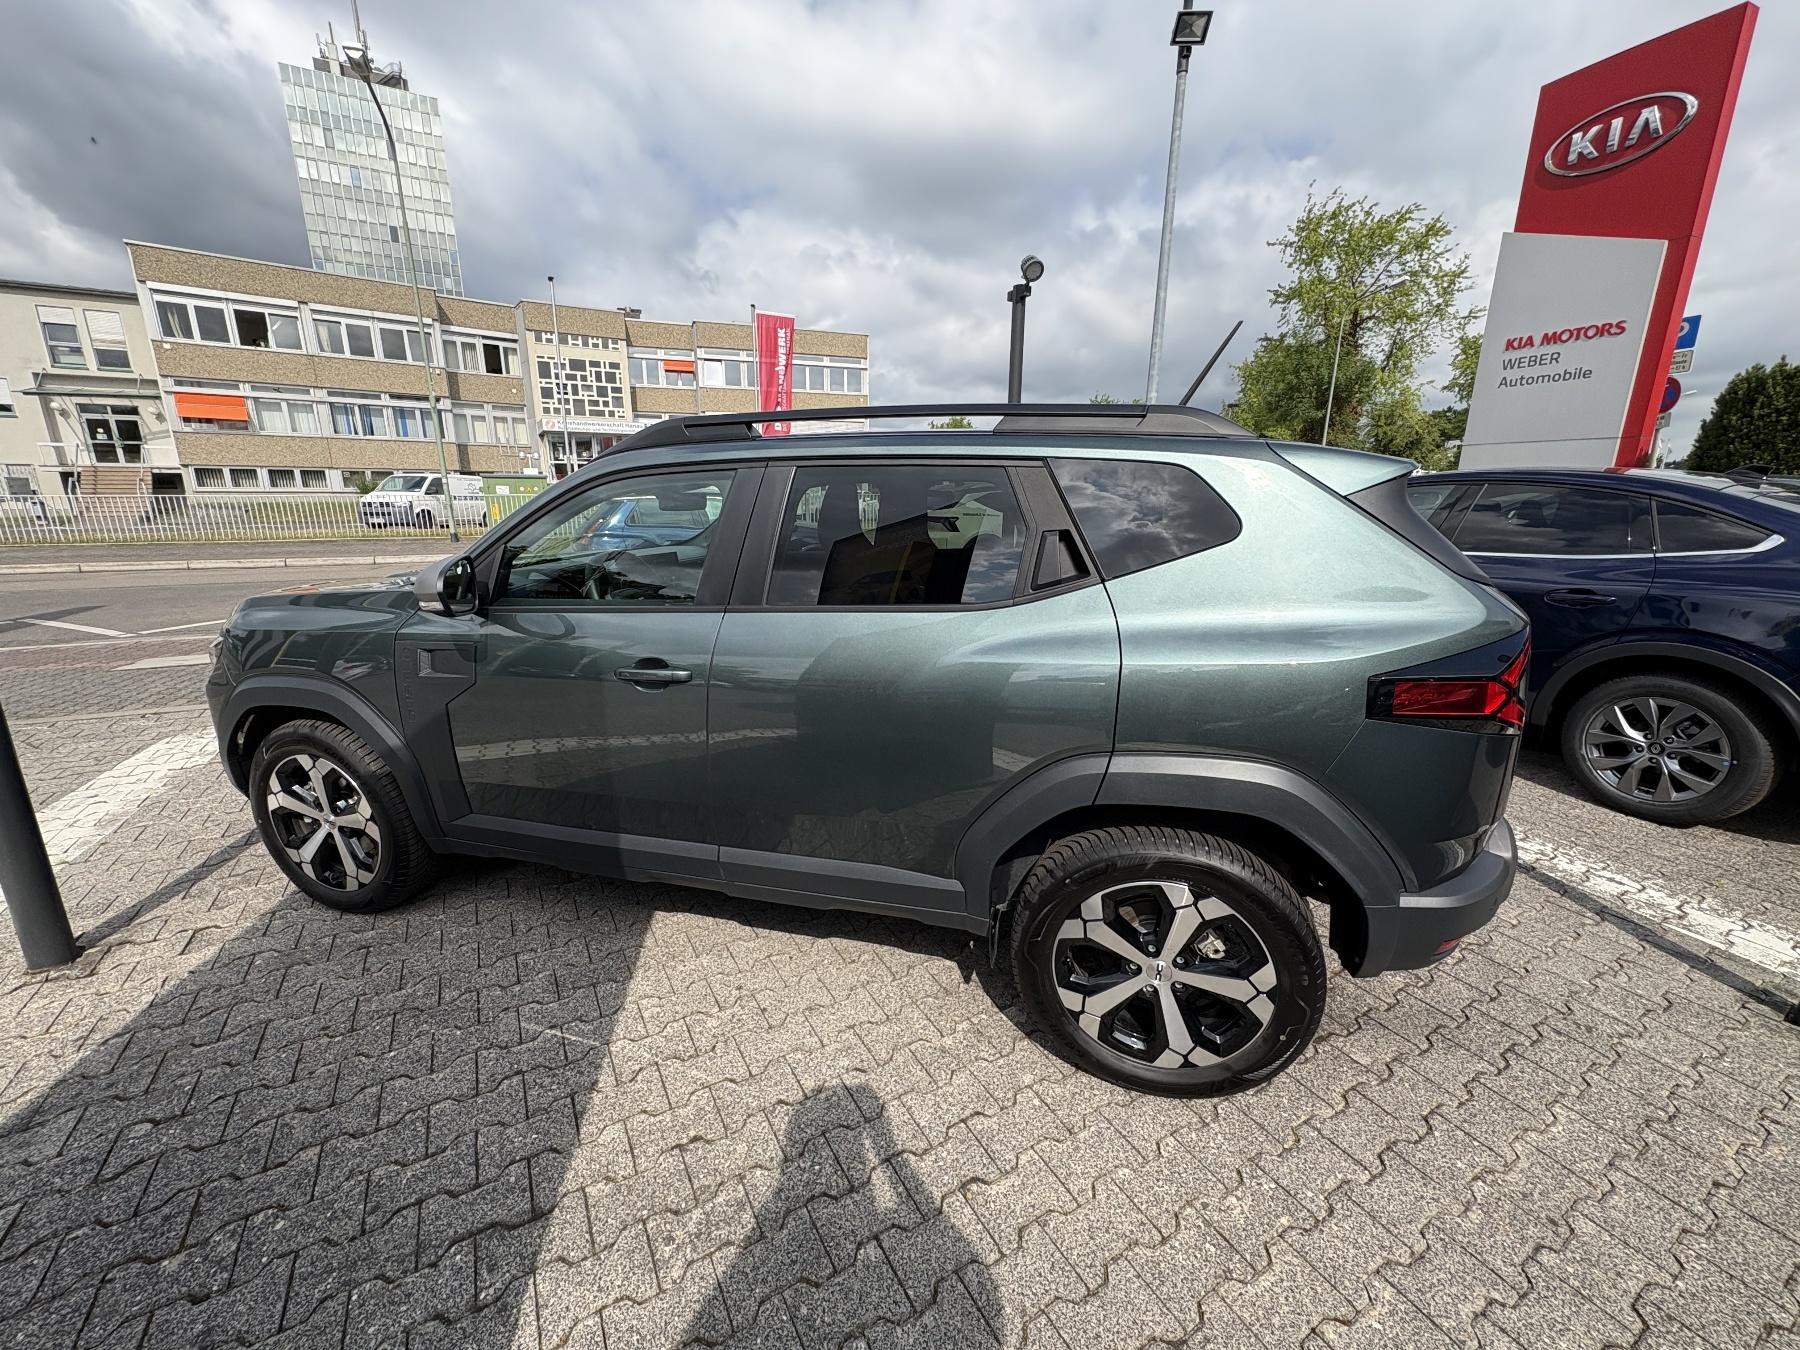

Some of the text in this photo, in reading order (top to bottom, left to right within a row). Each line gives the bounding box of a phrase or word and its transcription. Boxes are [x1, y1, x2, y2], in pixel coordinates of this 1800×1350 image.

[1568, 105, 1662, 166] KIA
[1504, 320, 1627, 351] KIA MOTORS
[1502, 351, 1561, 371] WEBER
[1497, 366, 1593, 389] Automobile
